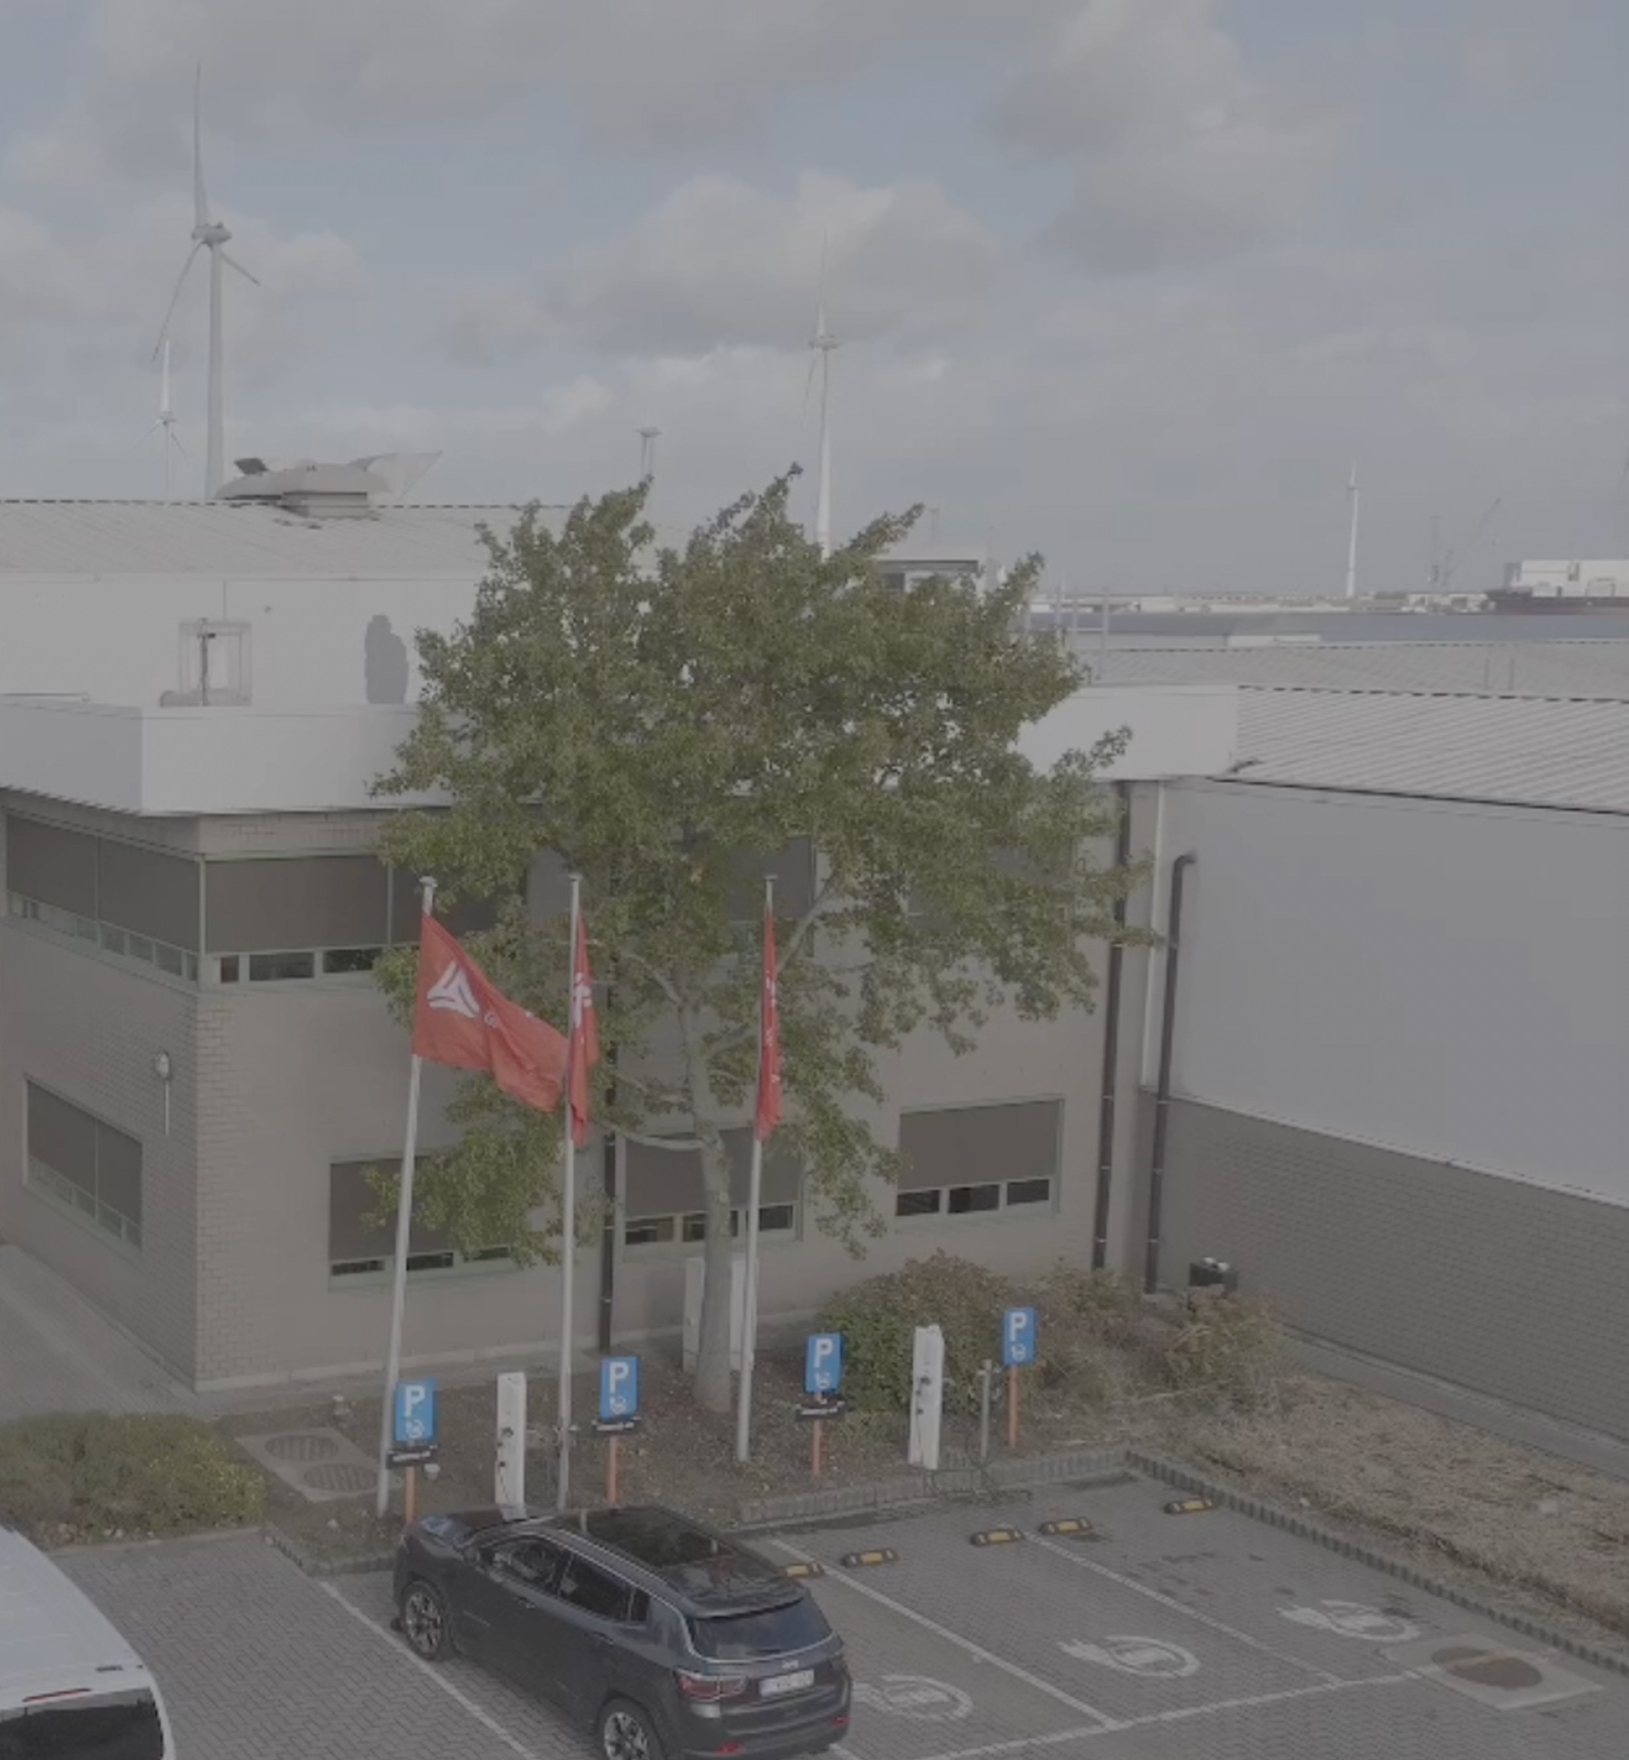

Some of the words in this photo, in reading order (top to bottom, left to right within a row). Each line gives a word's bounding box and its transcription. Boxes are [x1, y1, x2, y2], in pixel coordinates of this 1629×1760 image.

[1009, 1311, 1027, 1342] P
[814, 1338, 833, 1369] P
[609, 1361, 629, 1394] P
[405, 1385, 426, 1417] P
